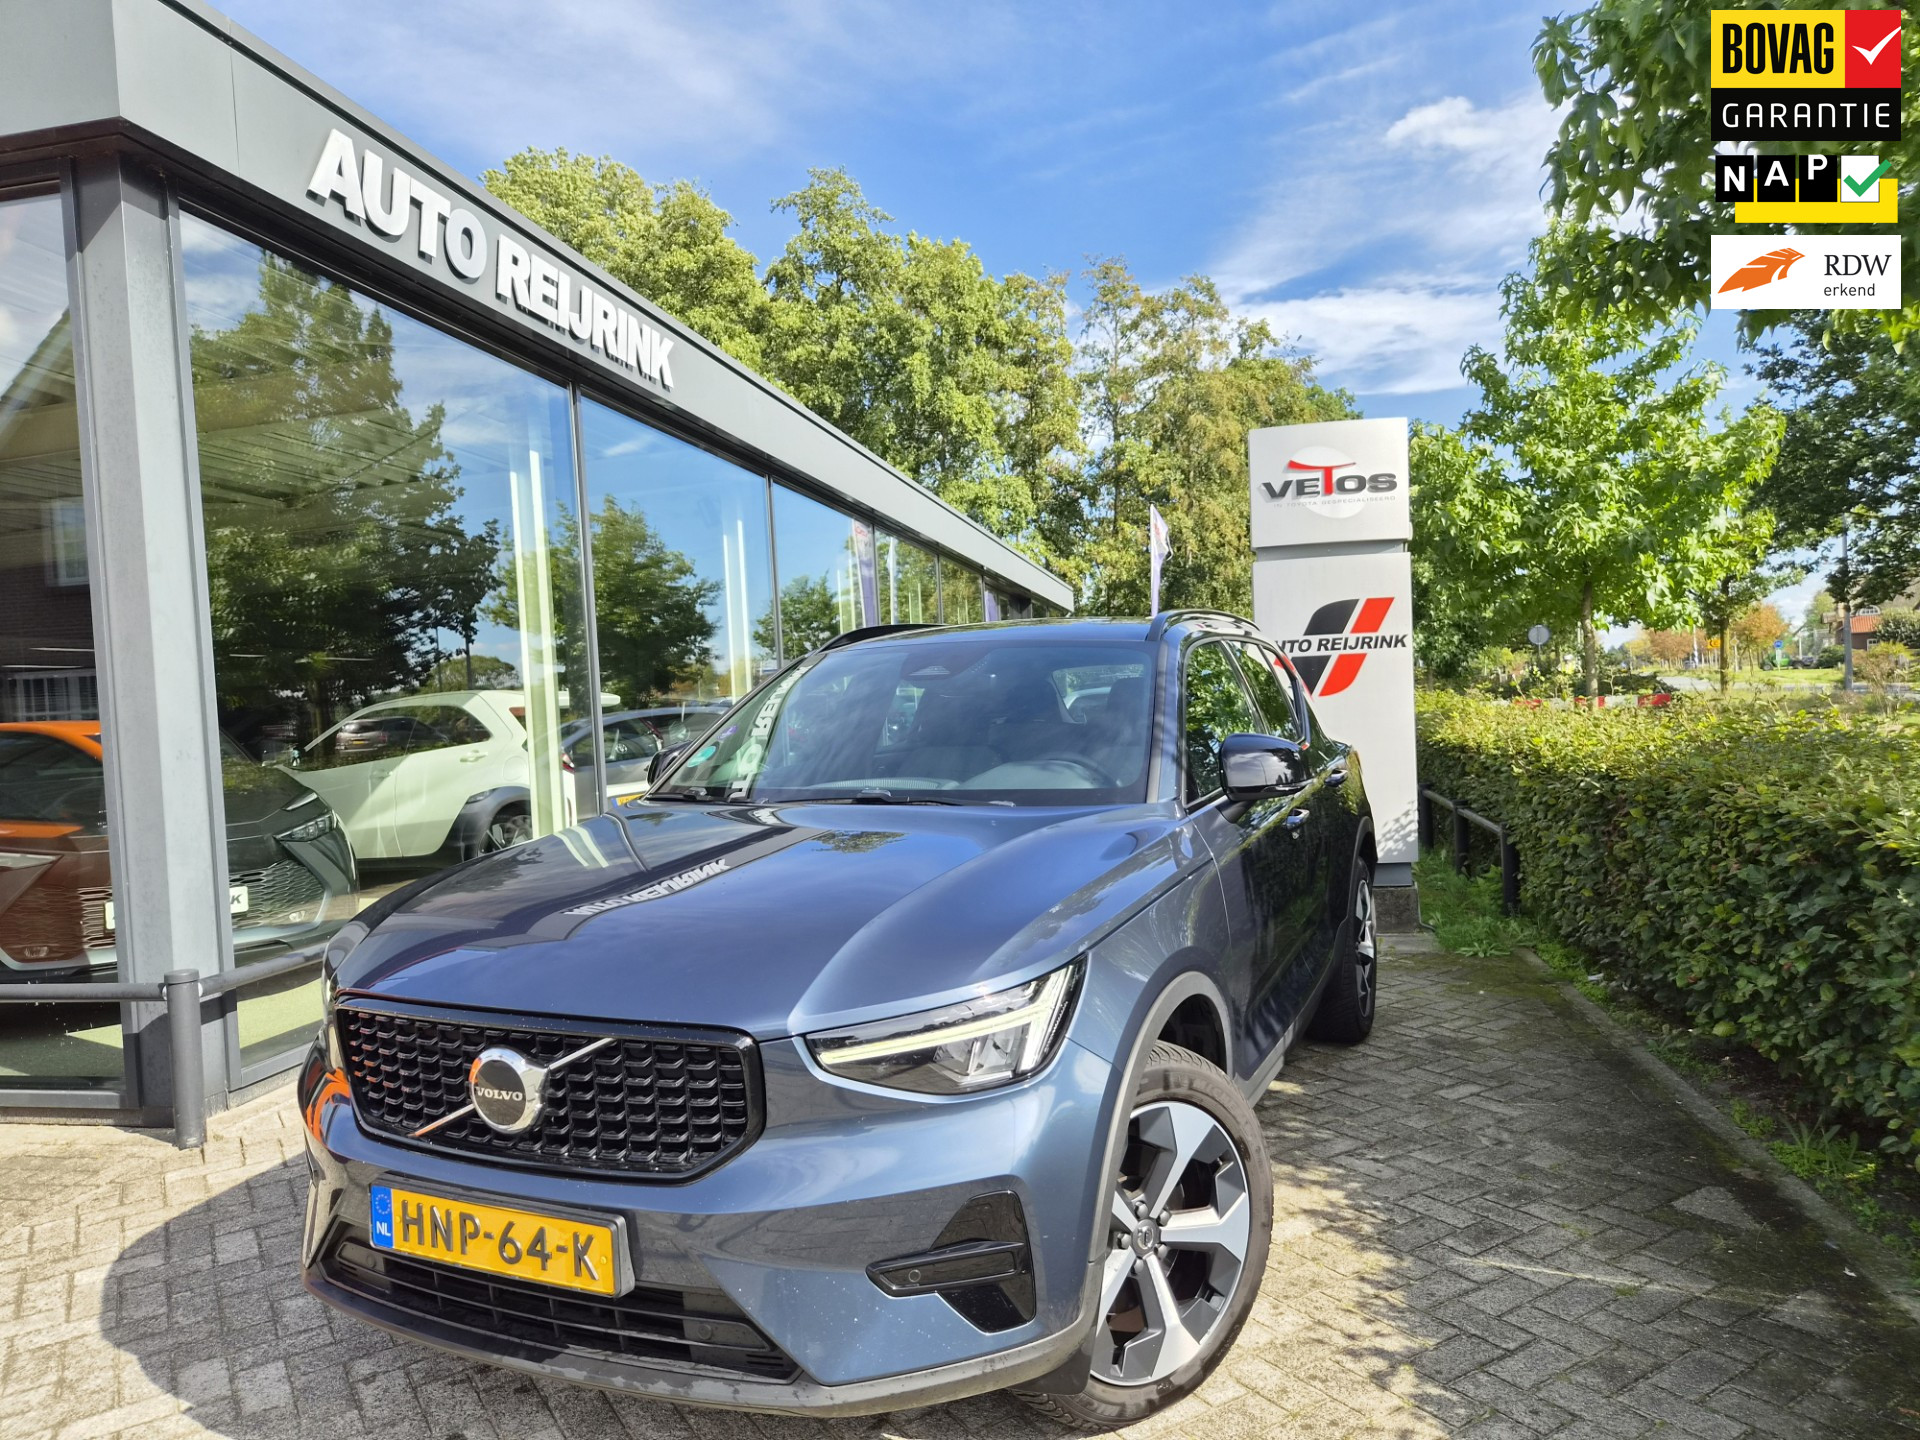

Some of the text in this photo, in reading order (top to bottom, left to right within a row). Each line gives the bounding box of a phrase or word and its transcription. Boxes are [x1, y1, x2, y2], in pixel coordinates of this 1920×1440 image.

[306, 128, 675, 391] AUTO REIJRINK
[1261, 459, 1398, 499] VETOS
[1275, 634, 1408, 653] UTO REIJRINK
[475, 1086, 523, 1101] VOLVO
[376, 1199, 600, 1282] NL HNP-64-K
